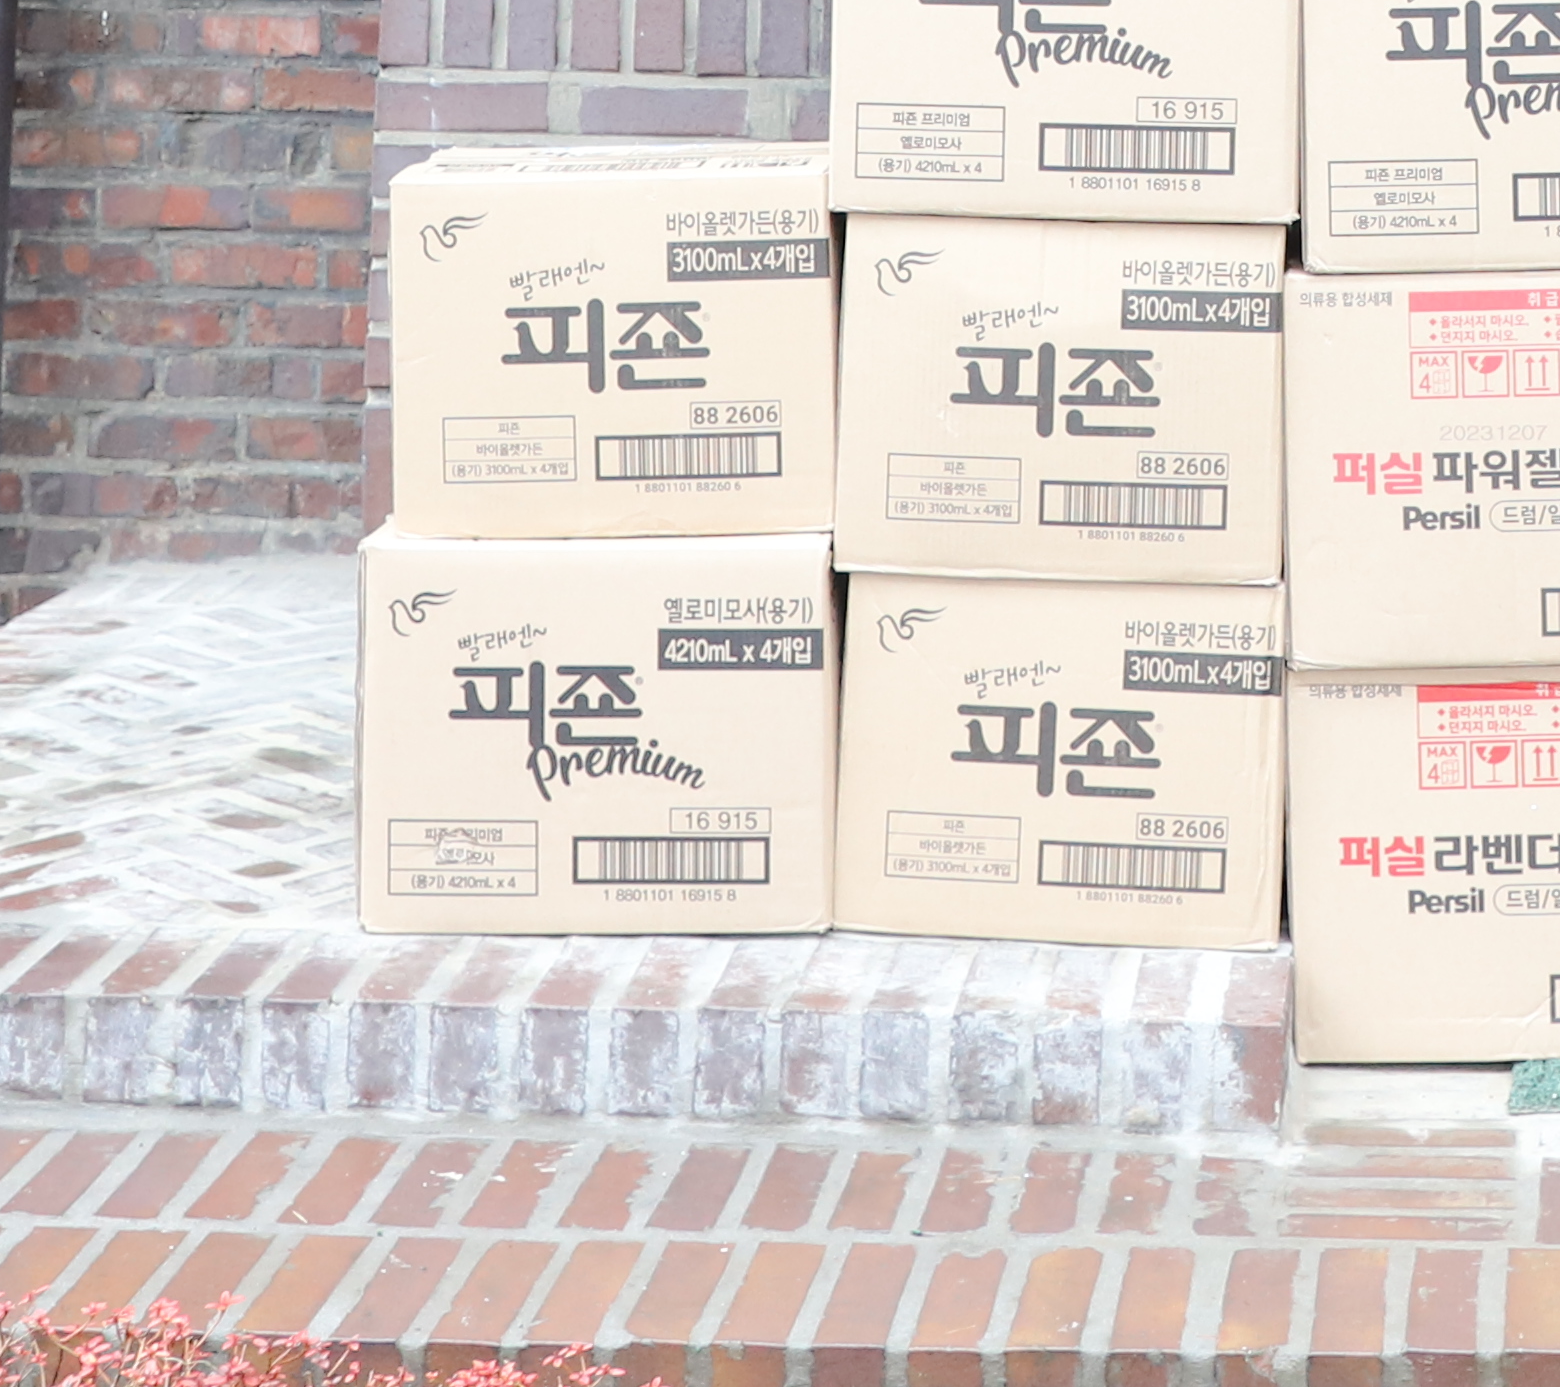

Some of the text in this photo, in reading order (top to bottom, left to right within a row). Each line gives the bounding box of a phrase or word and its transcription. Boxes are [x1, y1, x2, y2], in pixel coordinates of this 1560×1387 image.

[995, 28, 1173, 88] Premium
[921, 112, 970, 127] 프리미엄
[1151, 102, 1224, 119] 16 915
[915, 159, 959, 173] 4210mL
[975, 162, 981, 173] 4
[1069, 177, 1200, 191] 1 8801101 16915 8
[666, 210, 819, 235] 바이올렛가든(용기)
[1122, 260, 1275, 287] 바이올렛가든(용기)
[1300, 292, 1393, 307] 의류용 합성세제
[501, 298, 710, 394] 피죤
[1418, 356, 1450, 367] MAX
[950, 342, 1160, 438] 피죤
[1419, 377, 1431, 392] 4
[693, 405, 778, 425] 88 2606
[1440, 425, 1547, 442] 20231207
[1141, 457, 1226, 476] 88 2606
[1332, 452, 1422, 495] 퍼실
[1403, 504, 1480, 531] Persil
[664, 597, 813, 624] 옐로미모사(용기)
[1125, 621, 1276, 650] 바이올렛가든(용기)
[664, 637, 812, 664] 4210mL x 4개입
[449, 661, 643, 748] 피죤
[951, 701, 1161, 798] 피죤
[526, 740, 705, 801] Premium
[685, 812, 758, 829] 16 915
[1140, 819, 1225, 839] 88 2606
[1339, 835, 1425, 877] 퍼실
[1409, 889, 1484, 914] Persil
